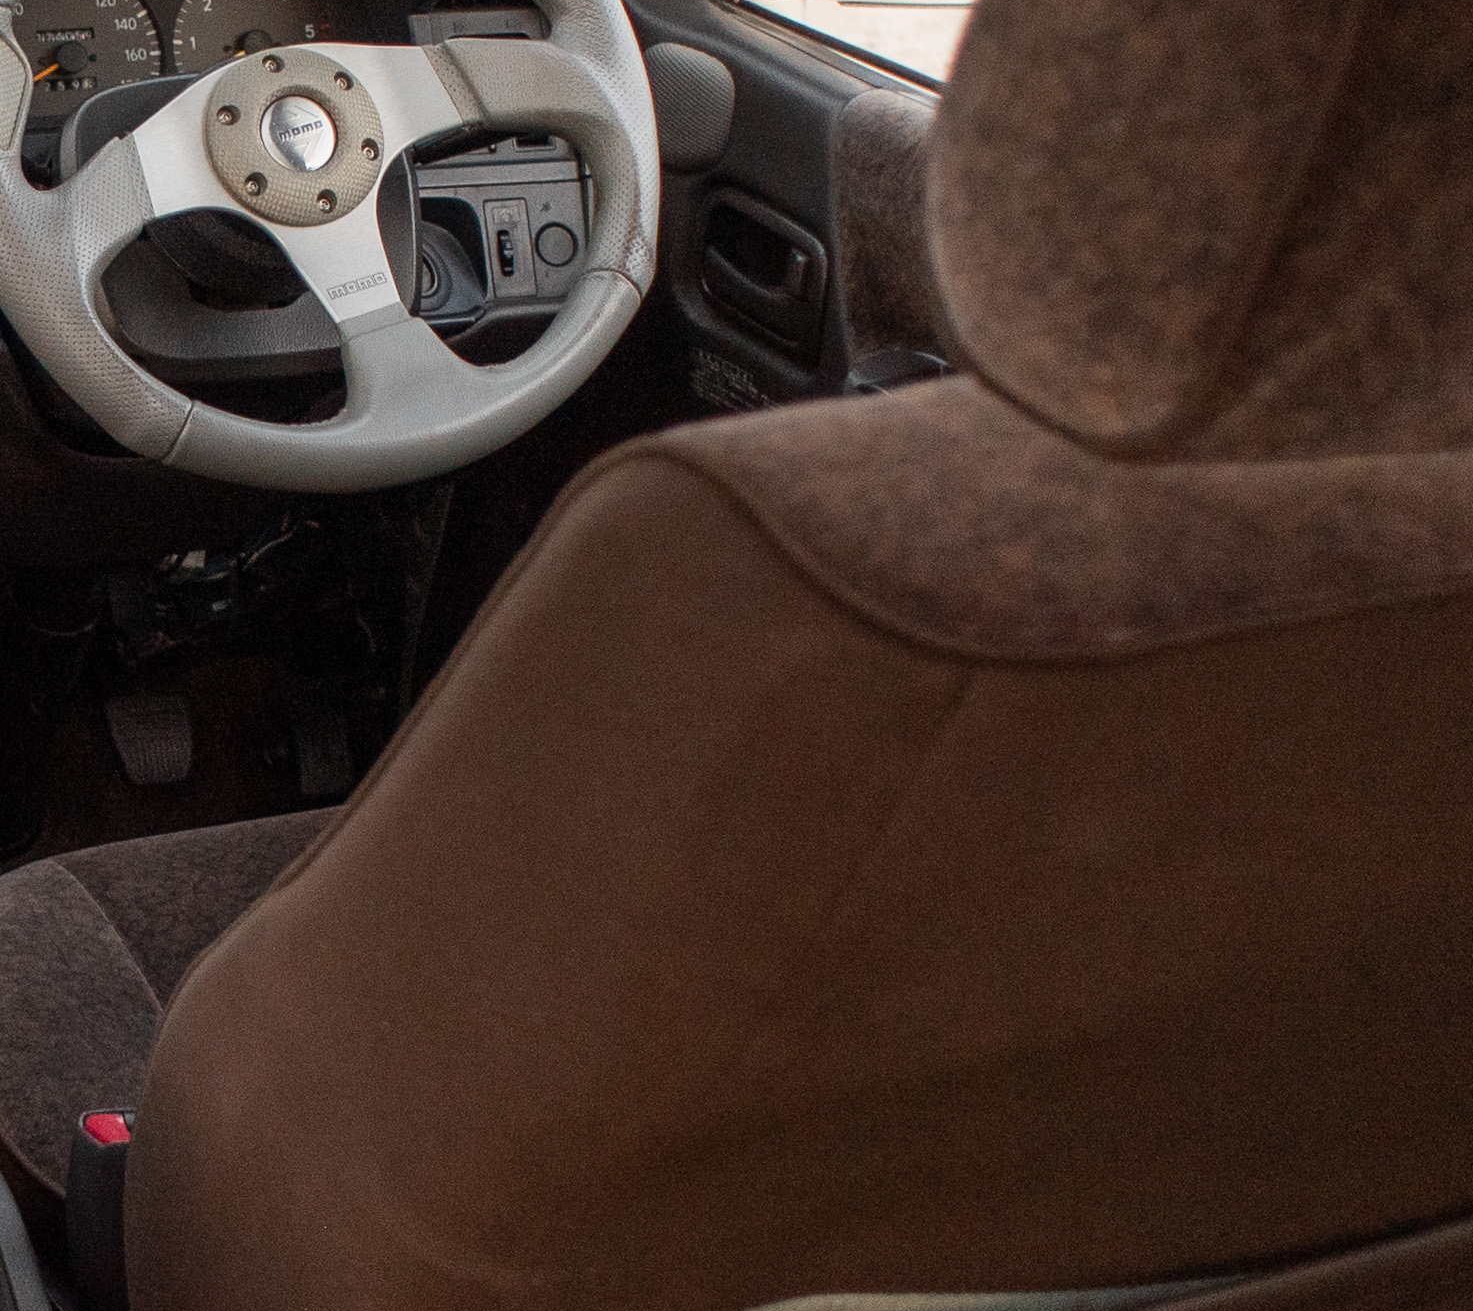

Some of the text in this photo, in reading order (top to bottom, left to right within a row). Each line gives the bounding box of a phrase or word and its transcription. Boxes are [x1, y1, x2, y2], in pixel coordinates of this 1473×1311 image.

[114, 17, 138, 31] 140
[304, 23, 316, 39] 5
[188, 35, 197, 51] 1
[124, 47, 148, 62] 160
[326, 271, 388, 301] momo
